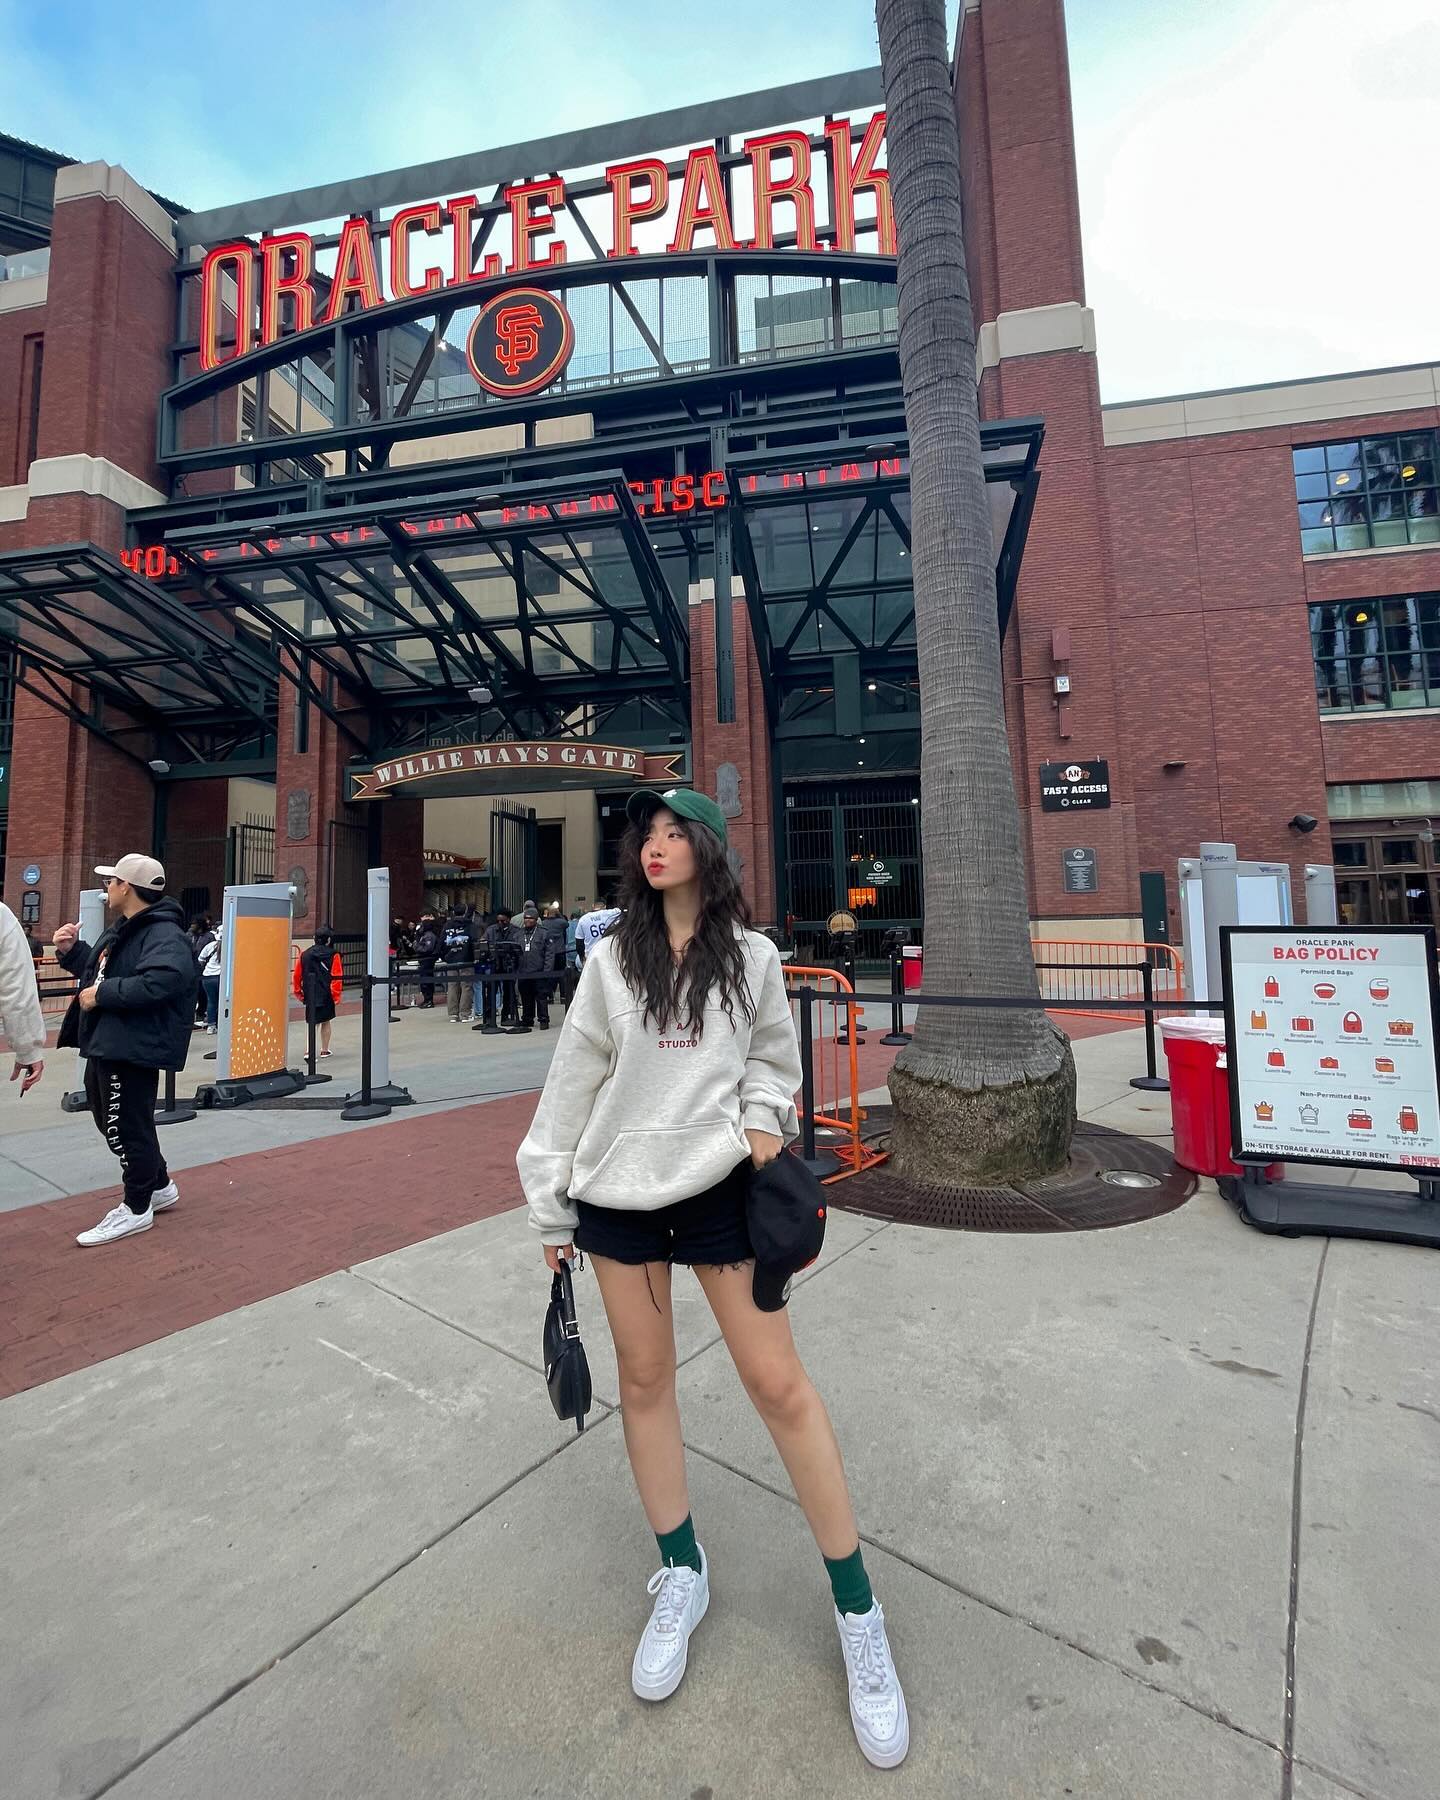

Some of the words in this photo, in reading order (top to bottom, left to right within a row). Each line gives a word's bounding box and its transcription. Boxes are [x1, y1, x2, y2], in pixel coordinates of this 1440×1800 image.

[201, 176, 568, 371] ORACLE
[606, 112, 897, 258] PARK
[377, 751, 463, 783] WILLIE
[473, 746, 549, 765] MAYS
[561, 747, 637, 769] GATE
[1043, 787, 1068, 796] FAST
[1071, 784, 1107, 794] ACCESS
[1273, 947, 1308, 960] BAG
[1314, 947, 1379, 961] POLICY
[658, 1040, 697, 1049] STUDIO
[1300, 1091, 1352, 1100] Non-Permitted
[1275, 1144, 1308, 1153] STORAGE
[1309, 1147, 1350, 1156] AVAILABLE
[1369, 1151, 1392, 1159] RENT.
